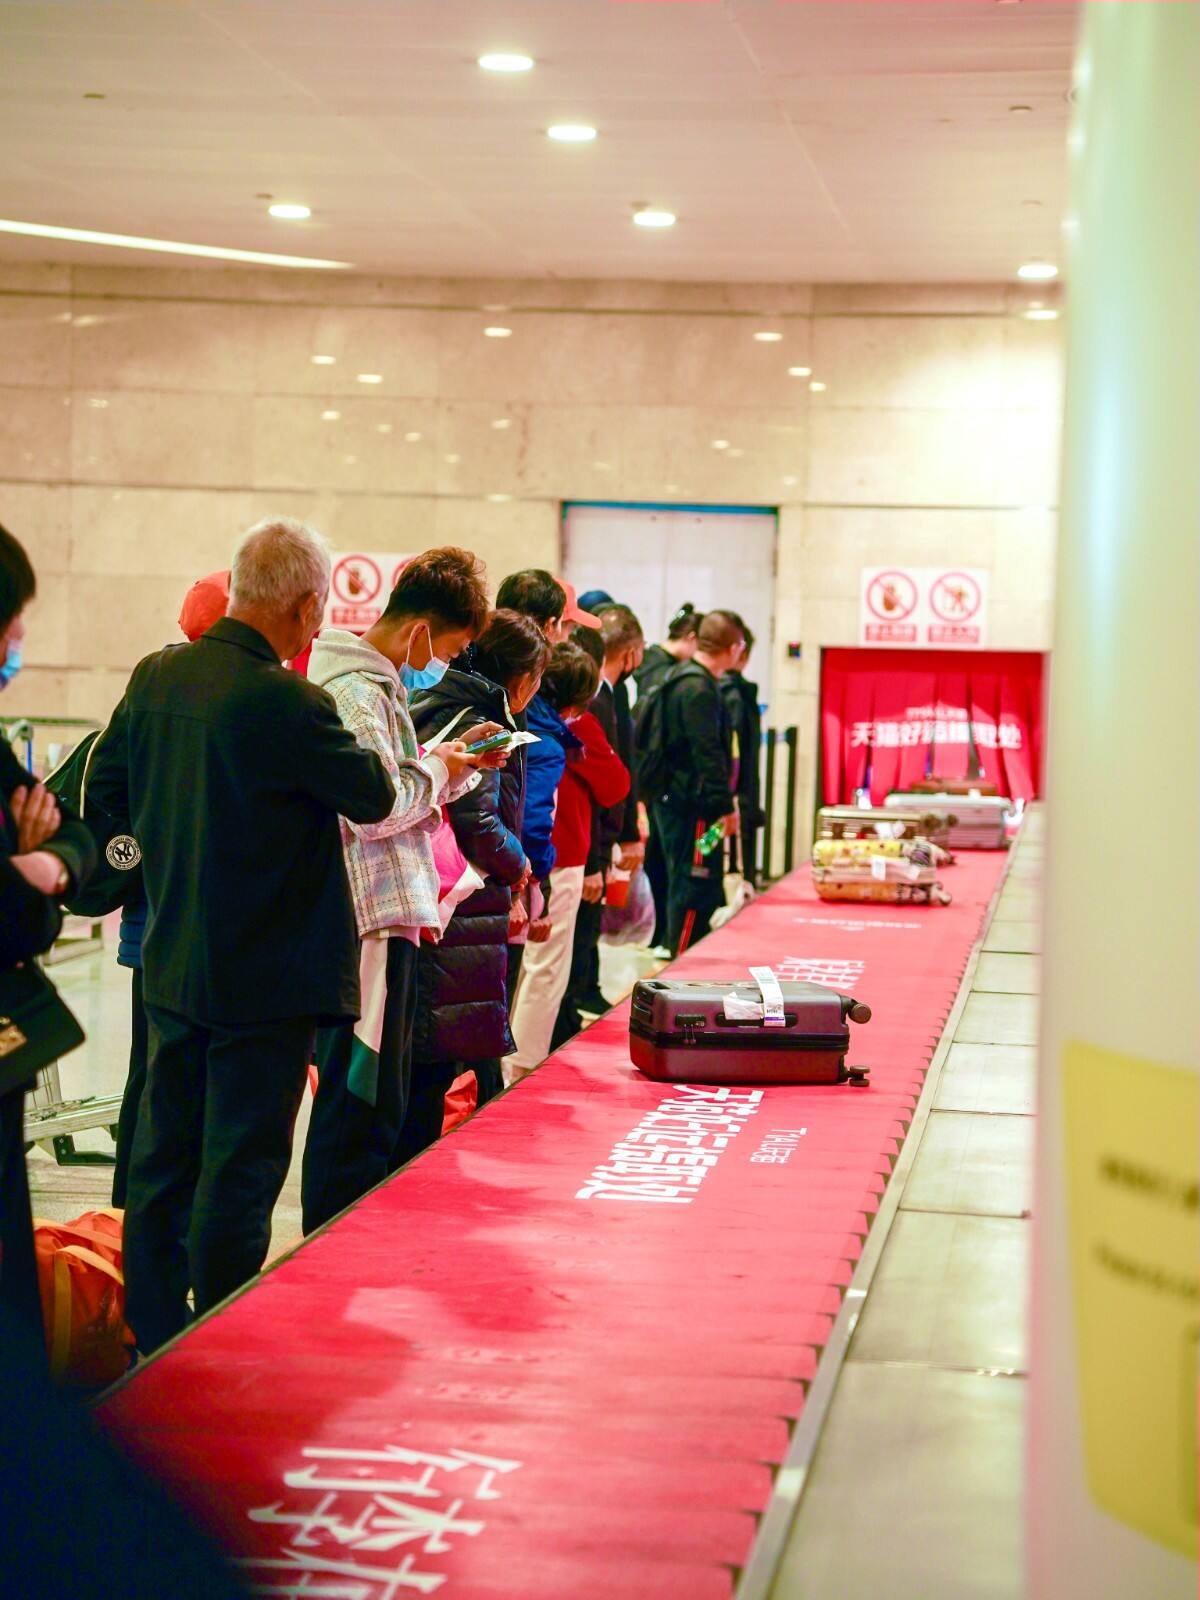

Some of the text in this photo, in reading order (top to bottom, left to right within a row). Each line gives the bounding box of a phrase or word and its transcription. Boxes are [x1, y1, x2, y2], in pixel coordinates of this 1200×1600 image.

[851, 721, 1022, 749] 天猫好运提取处
[574, 1084, 765, 1204] 天猫好运提取处
